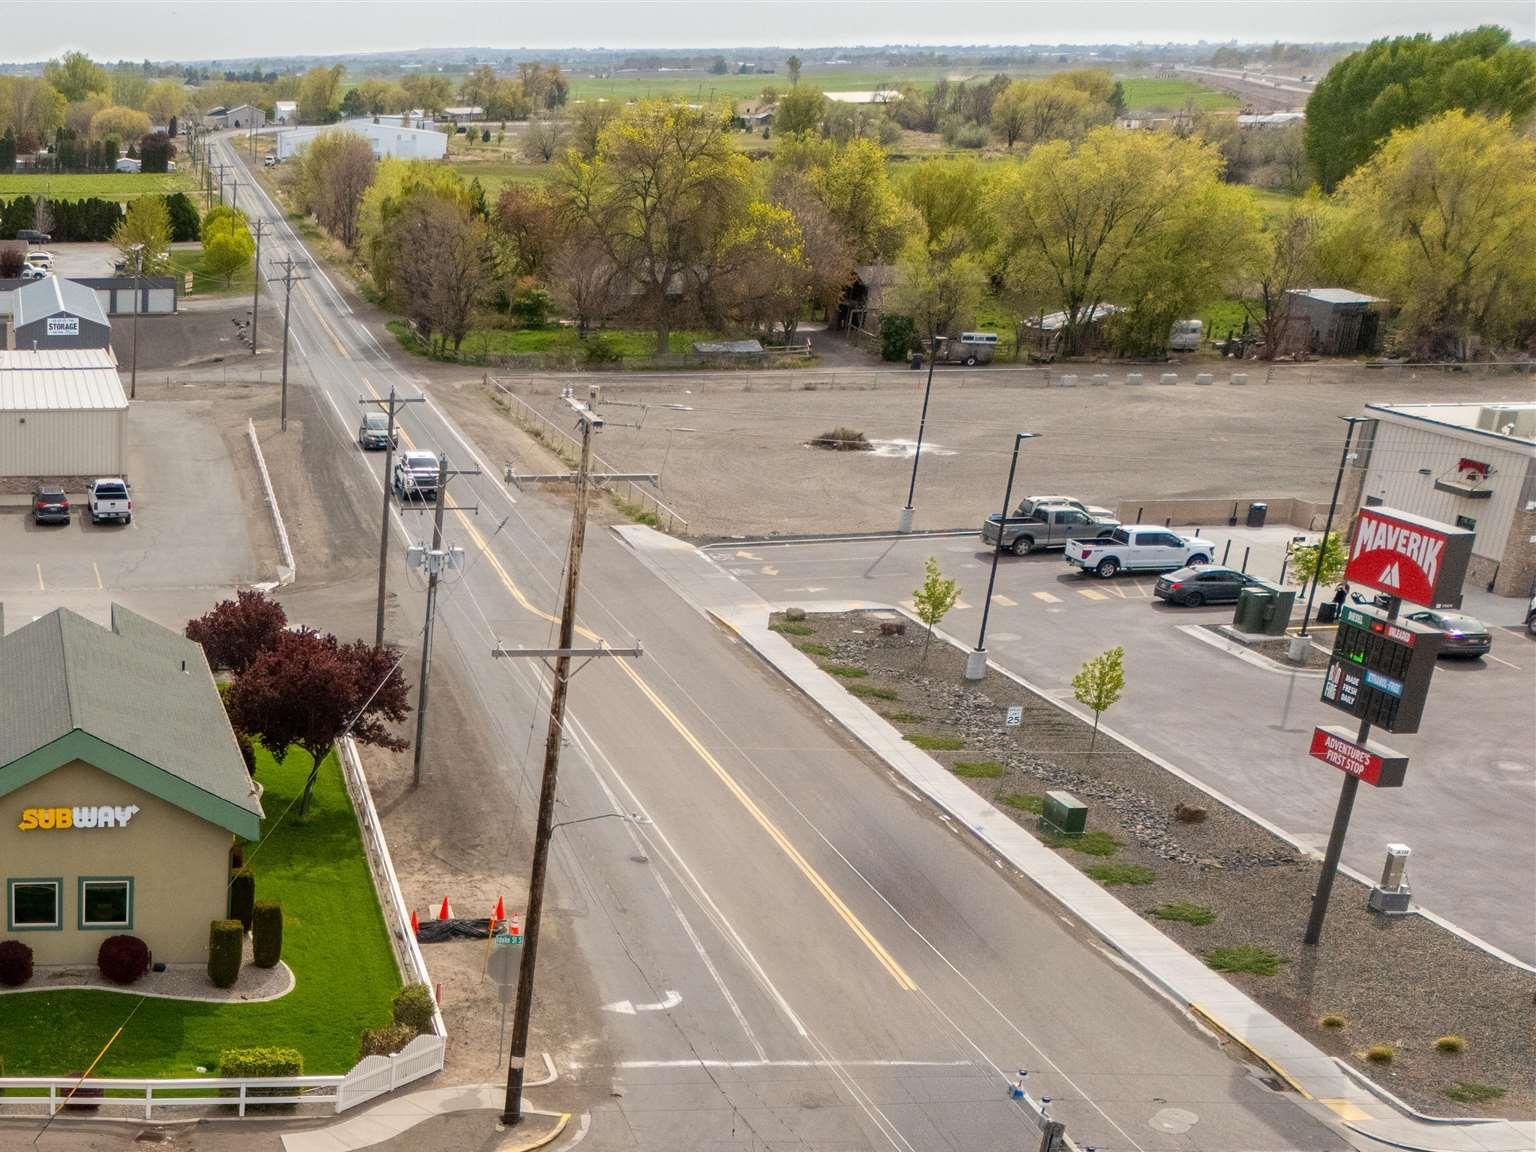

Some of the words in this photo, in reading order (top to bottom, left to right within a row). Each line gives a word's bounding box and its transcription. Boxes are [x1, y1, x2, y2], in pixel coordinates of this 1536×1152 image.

[1352, 516, 1444, 588] MAVERIK
[1325, 736, 1371, 766] ADVENTURE'S
[1326, 749, 1346, 767] FIRST
[1345, 758, 1365, 775] STOP
[16, 804, 140, 831] SUBWAY
